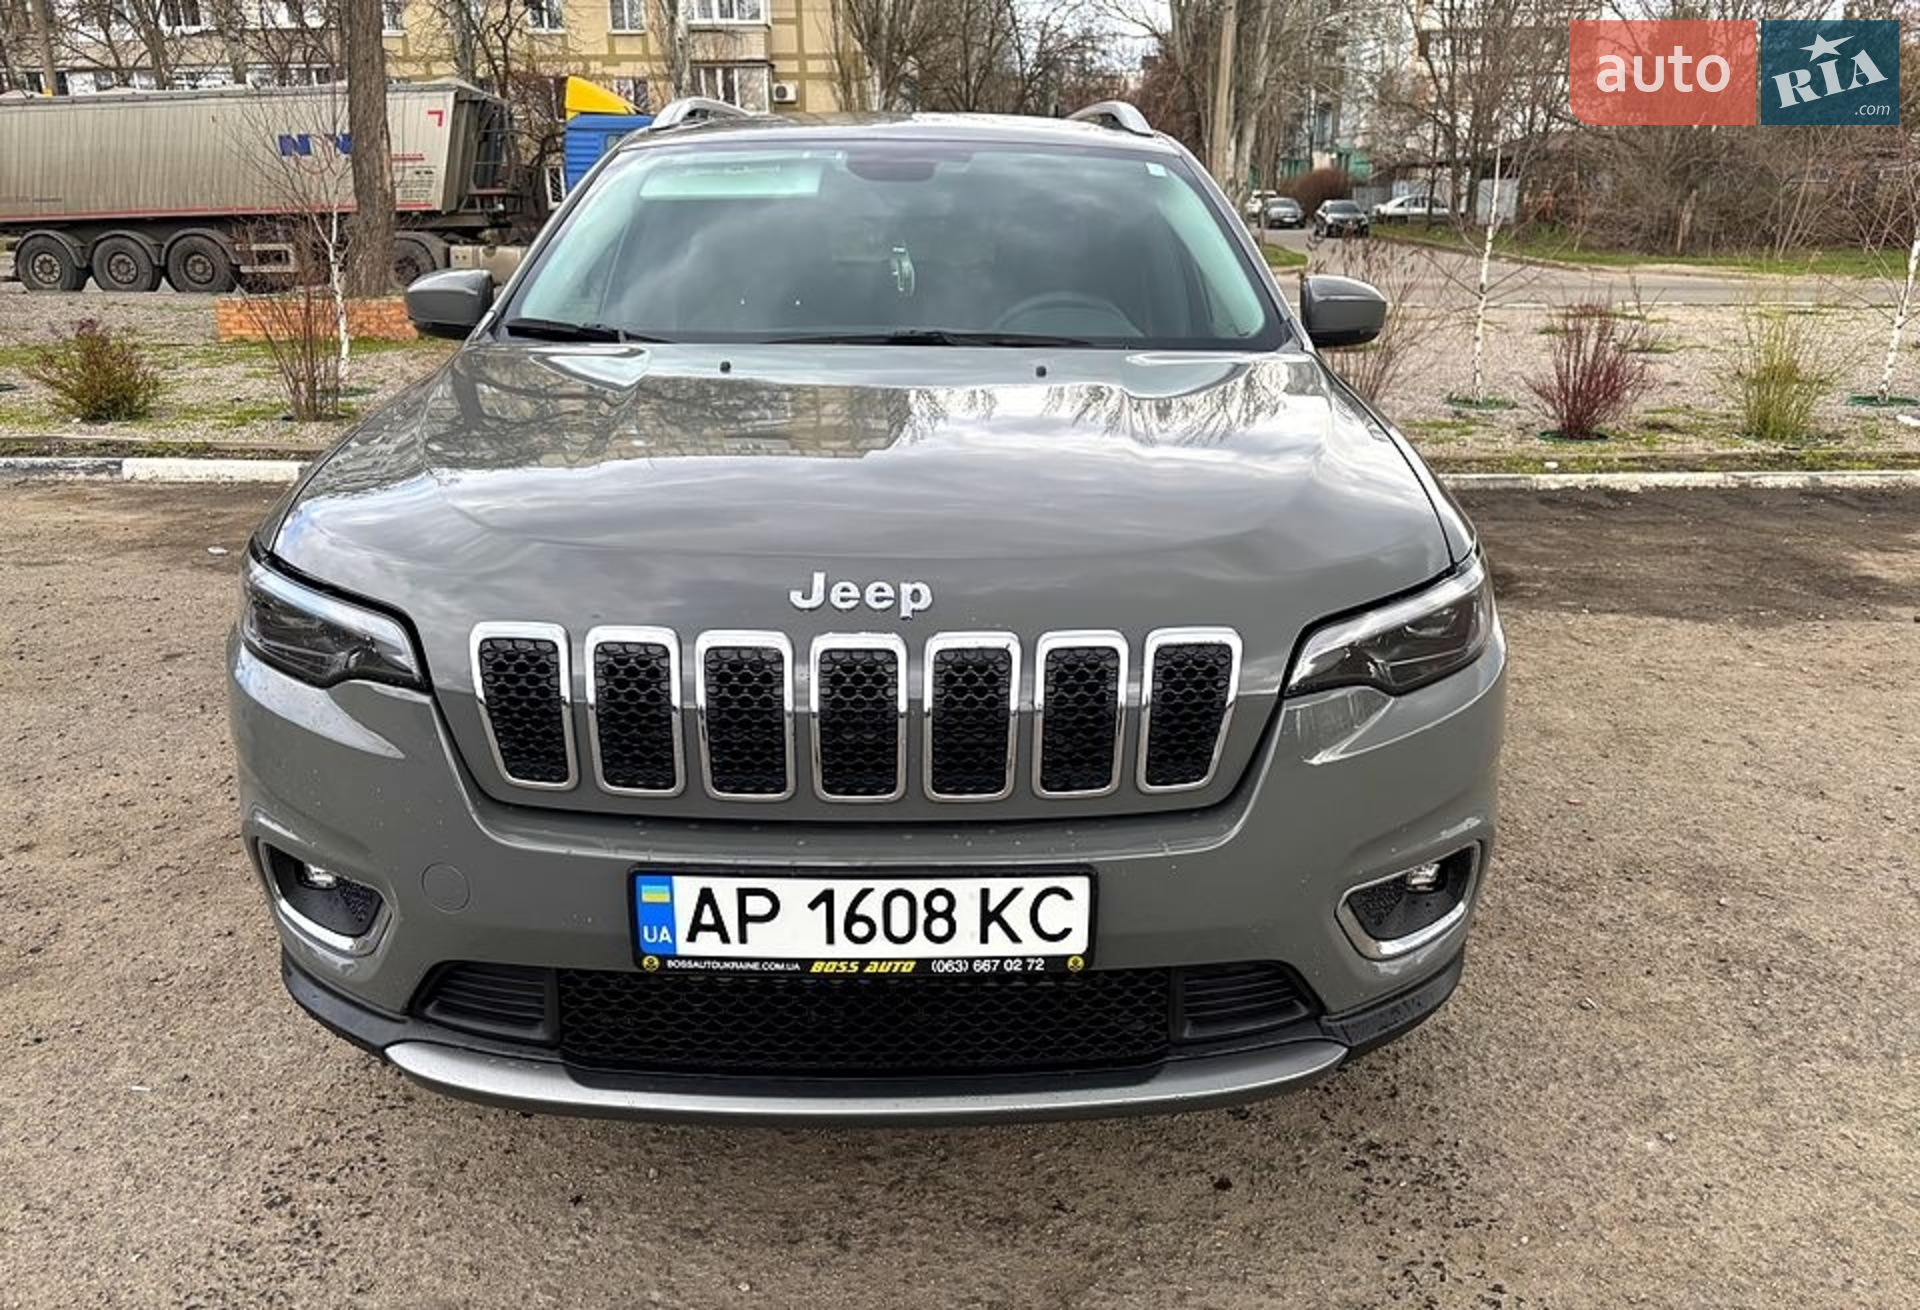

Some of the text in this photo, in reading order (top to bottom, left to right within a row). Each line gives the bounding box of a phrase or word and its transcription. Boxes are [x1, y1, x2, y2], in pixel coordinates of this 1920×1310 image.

[789, 571, 933, 619] Jeep
[685, 886, 1076, 945] AP 1608 KC
[643, 926, 672, 944] UA
[809, 961, 859, 973] BOSS
[931, 958, 1045, 973] (063) 667 02 72
